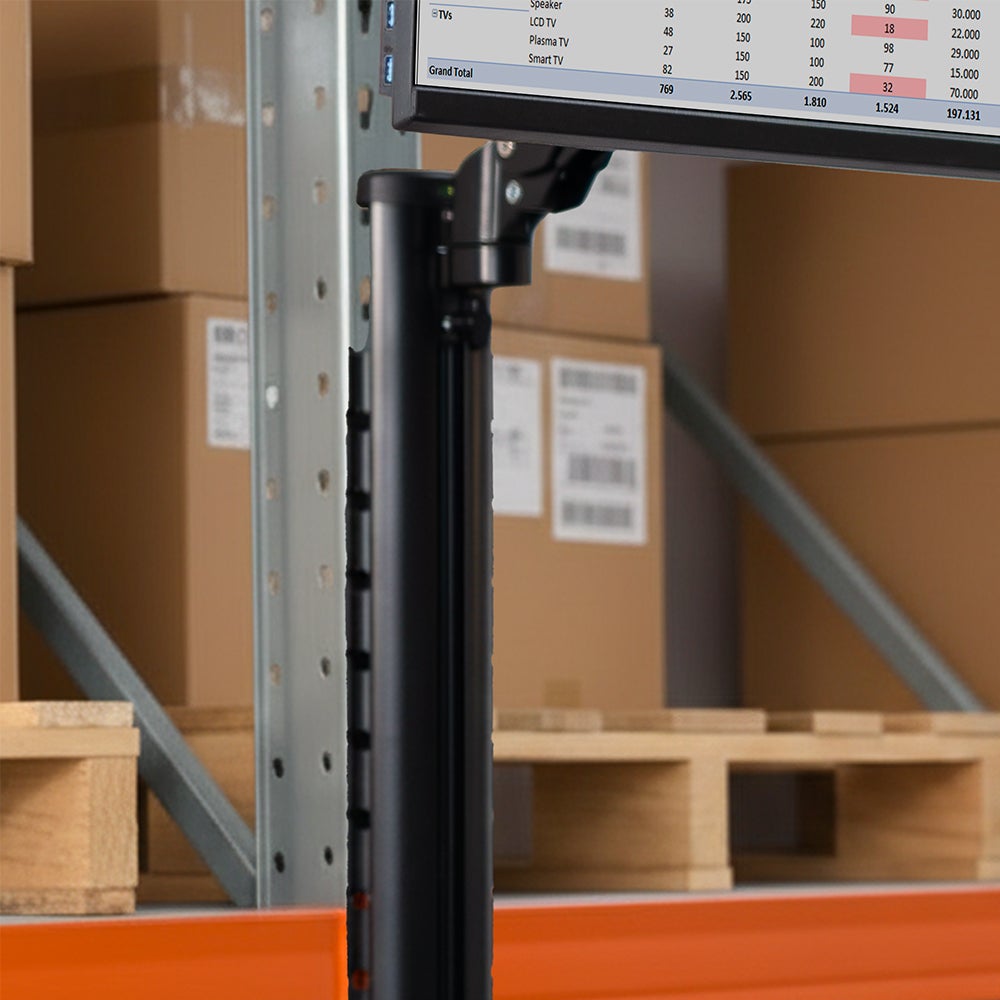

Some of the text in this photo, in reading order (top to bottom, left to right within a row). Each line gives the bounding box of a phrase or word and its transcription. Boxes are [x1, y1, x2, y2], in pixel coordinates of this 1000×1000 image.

[531, 0, 562, 10] Speaker
[812, 0, 826, 9] 150
[885, 4, 895, 14] 90
[439, 10, 452, 20] TVs
[665, 8, 674, 18] 38
[737, 13, 751, 23] 200
[952, 8, 980, 20] 30.000
[530, 17, 556, 27] LCD TV
[811, 18, 825, 28] 220
[664, 27, 673, 36] 48
[885, 24, 894, 34] 18
[952, 28, 980, 40] 22.000
[530, 35, 569, 47] Plasma TV
[736, 32, 750, 42] 150
[810, 38, 824, 48] 100
[884, 43, 894, 53] 98
[664, 46, 673, 55] 27
[951, 48, 979, 60] 29.000
[529, 54, 563, 65] Smart TV
[736, 52, 750, 61] 150
[810, 57, 824, 67] 100
[884, 62, 894, 72] 77
[429, 66, 472, 78] Grand Total
[663, 64, 672, 74] 82
[951, 68, 979, 80] 15.000
[736, 70, 750, 80] 150
[809, 76, 823, 87] 200
[660, 84, 673, 94] 769
[883, 82, 892, 92] 32
[730, 90, 752, 101] 2.565
[950, 88, 978, 99] 70.000
[805, 96, 826, 107] 1.810
[876, 102, 898, 113] 1.524
[948, 108, 980, 120] 197.131
